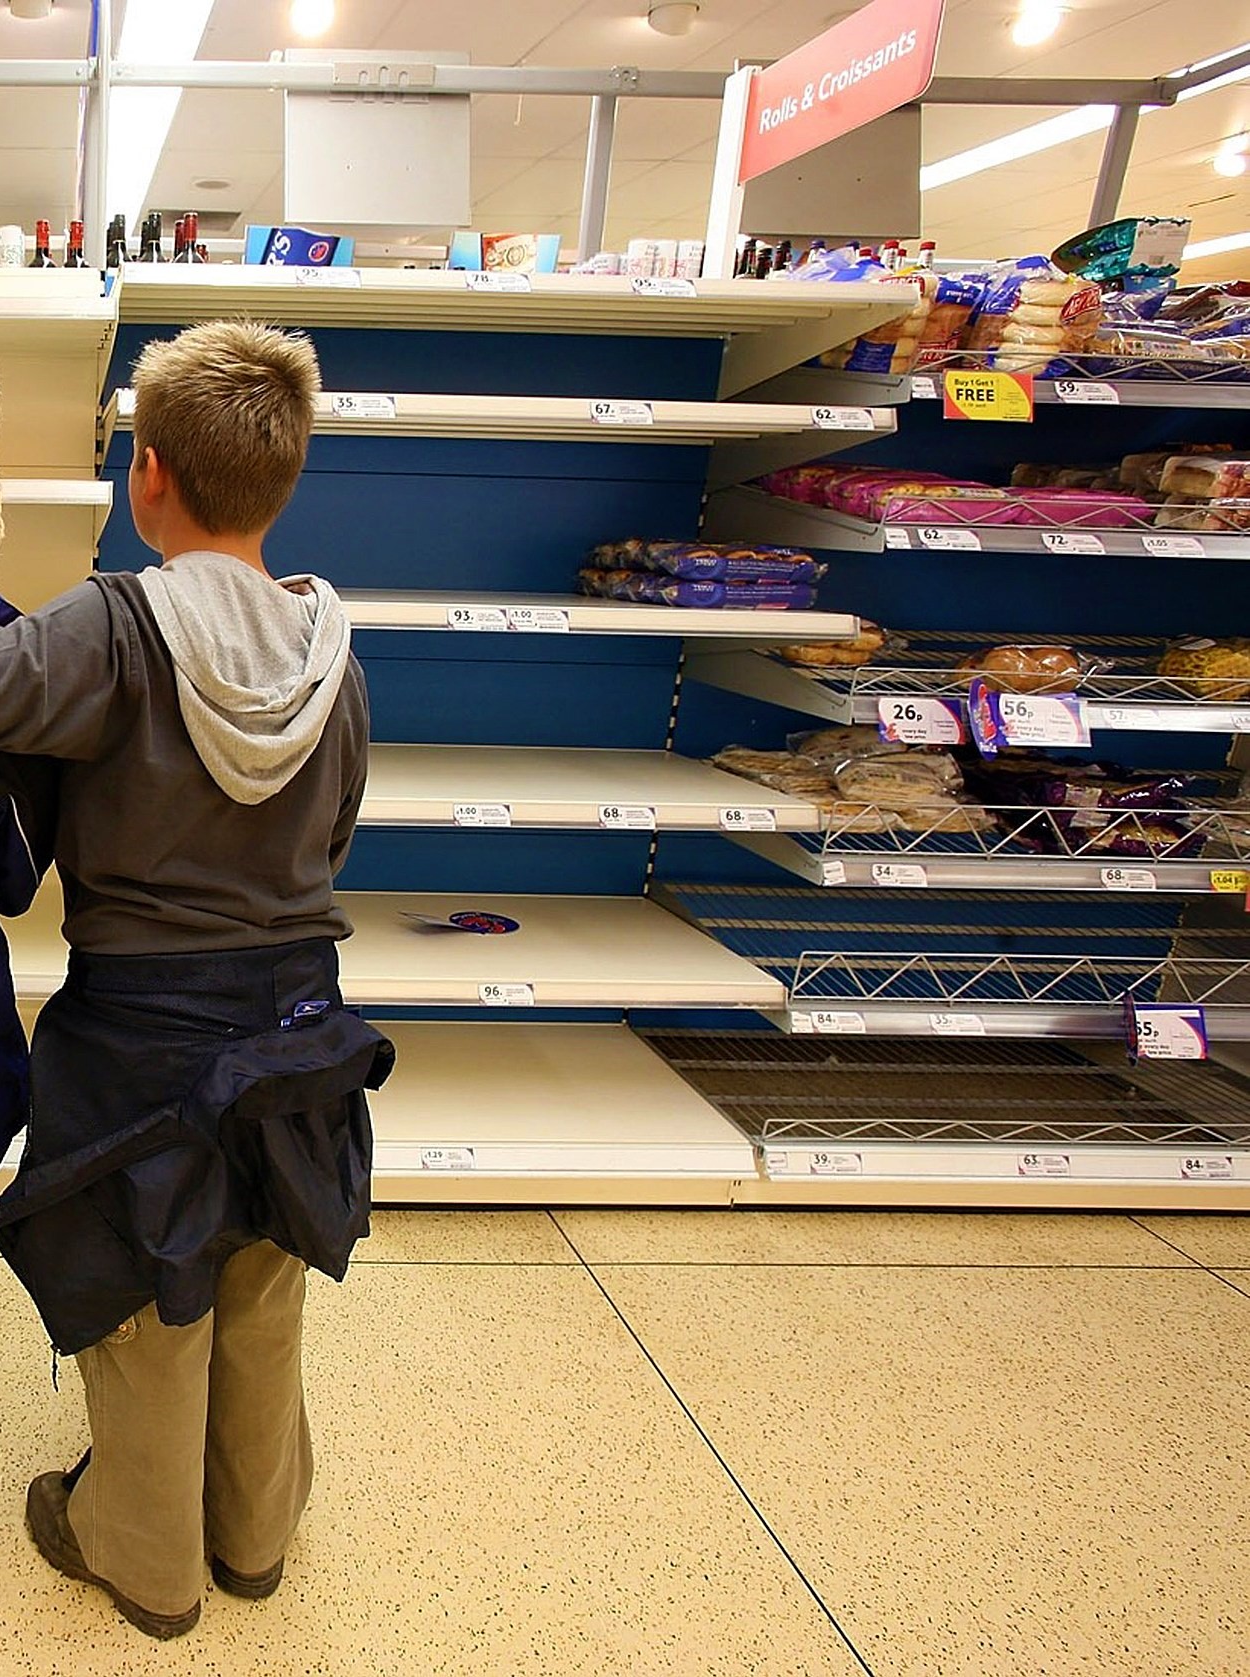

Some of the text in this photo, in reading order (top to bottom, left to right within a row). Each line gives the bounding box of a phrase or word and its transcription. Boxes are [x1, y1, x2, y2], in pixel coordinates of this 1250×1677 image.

[759, 29, 917, 134] Rolls & Croissants
[954, 378, 969, 388] Buy
[975, 379, 989, 388] Get
[956, 388, 995, 402] FREE
[893, 704, 923, 722] 26p
[1004, 700, 1033, 719] 56p
